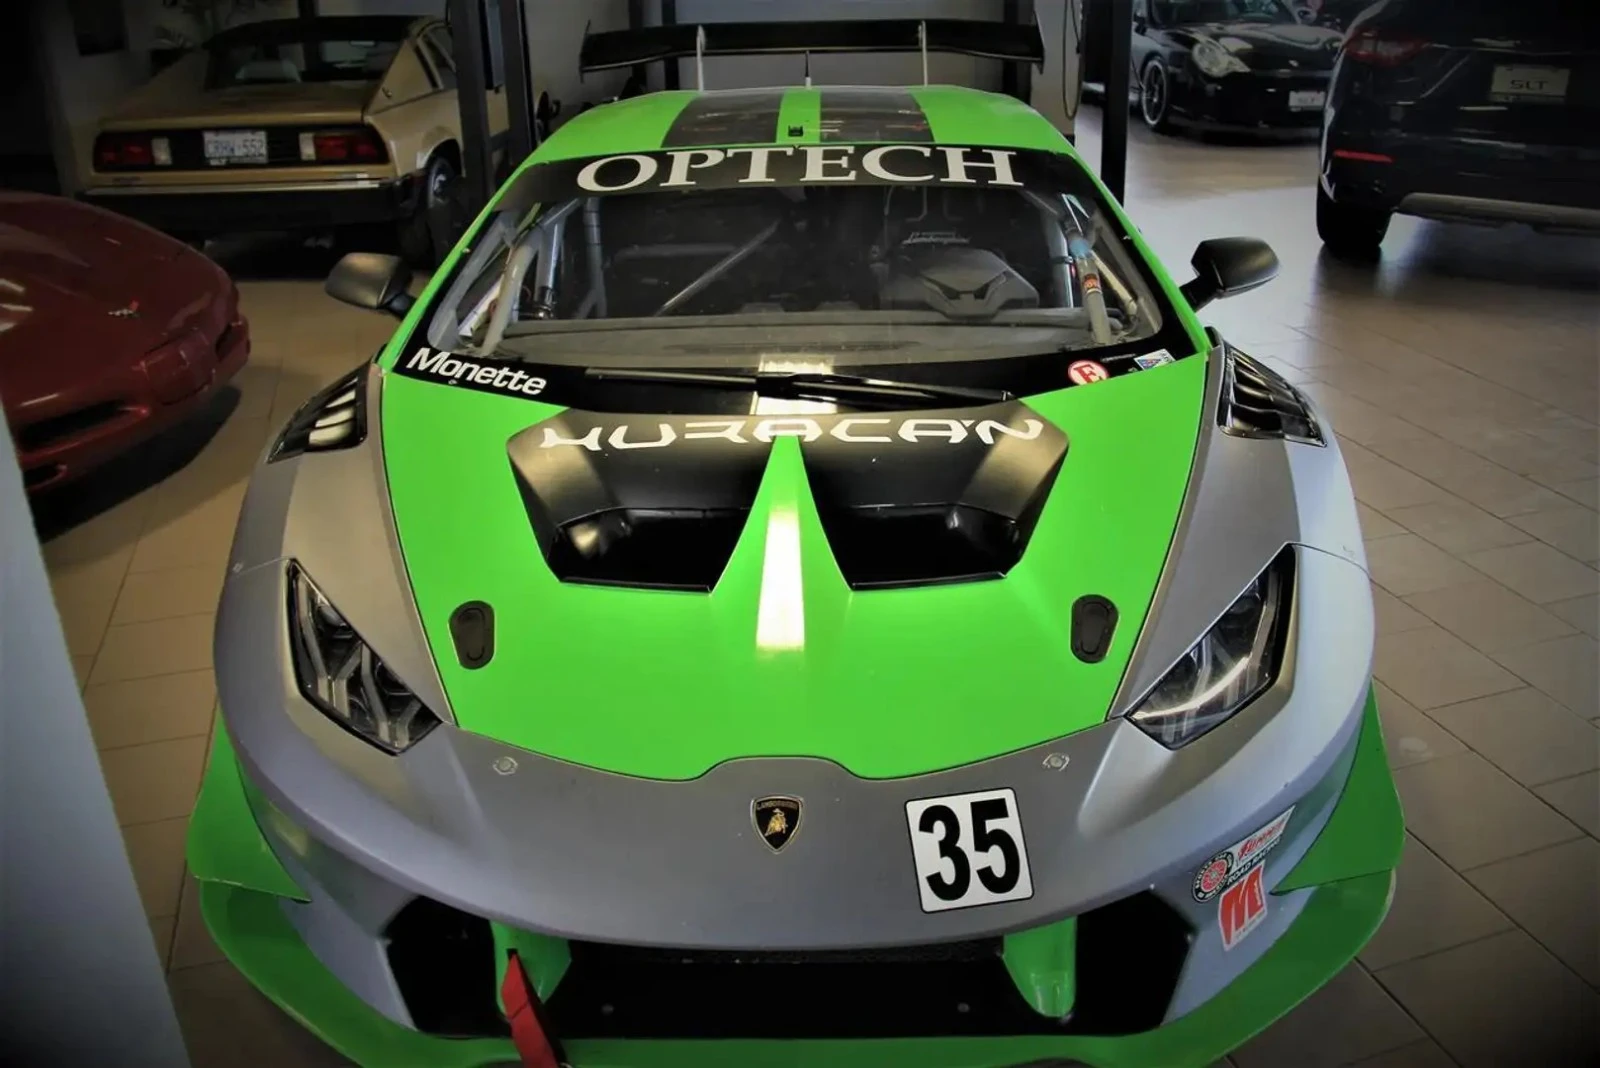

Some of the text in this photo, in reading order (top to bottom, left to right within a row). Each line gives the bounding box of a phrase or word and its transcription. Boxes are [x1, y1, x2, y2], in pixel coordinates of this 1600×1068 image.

[1510, 79, 1549, 90] SLT
[576, 145, 1024, 192] OPTECH
[406, 347, 547, 395] Monette
[918, 797, 1021, 902] 35
[1227, 862, 1251, 886] ROAD
